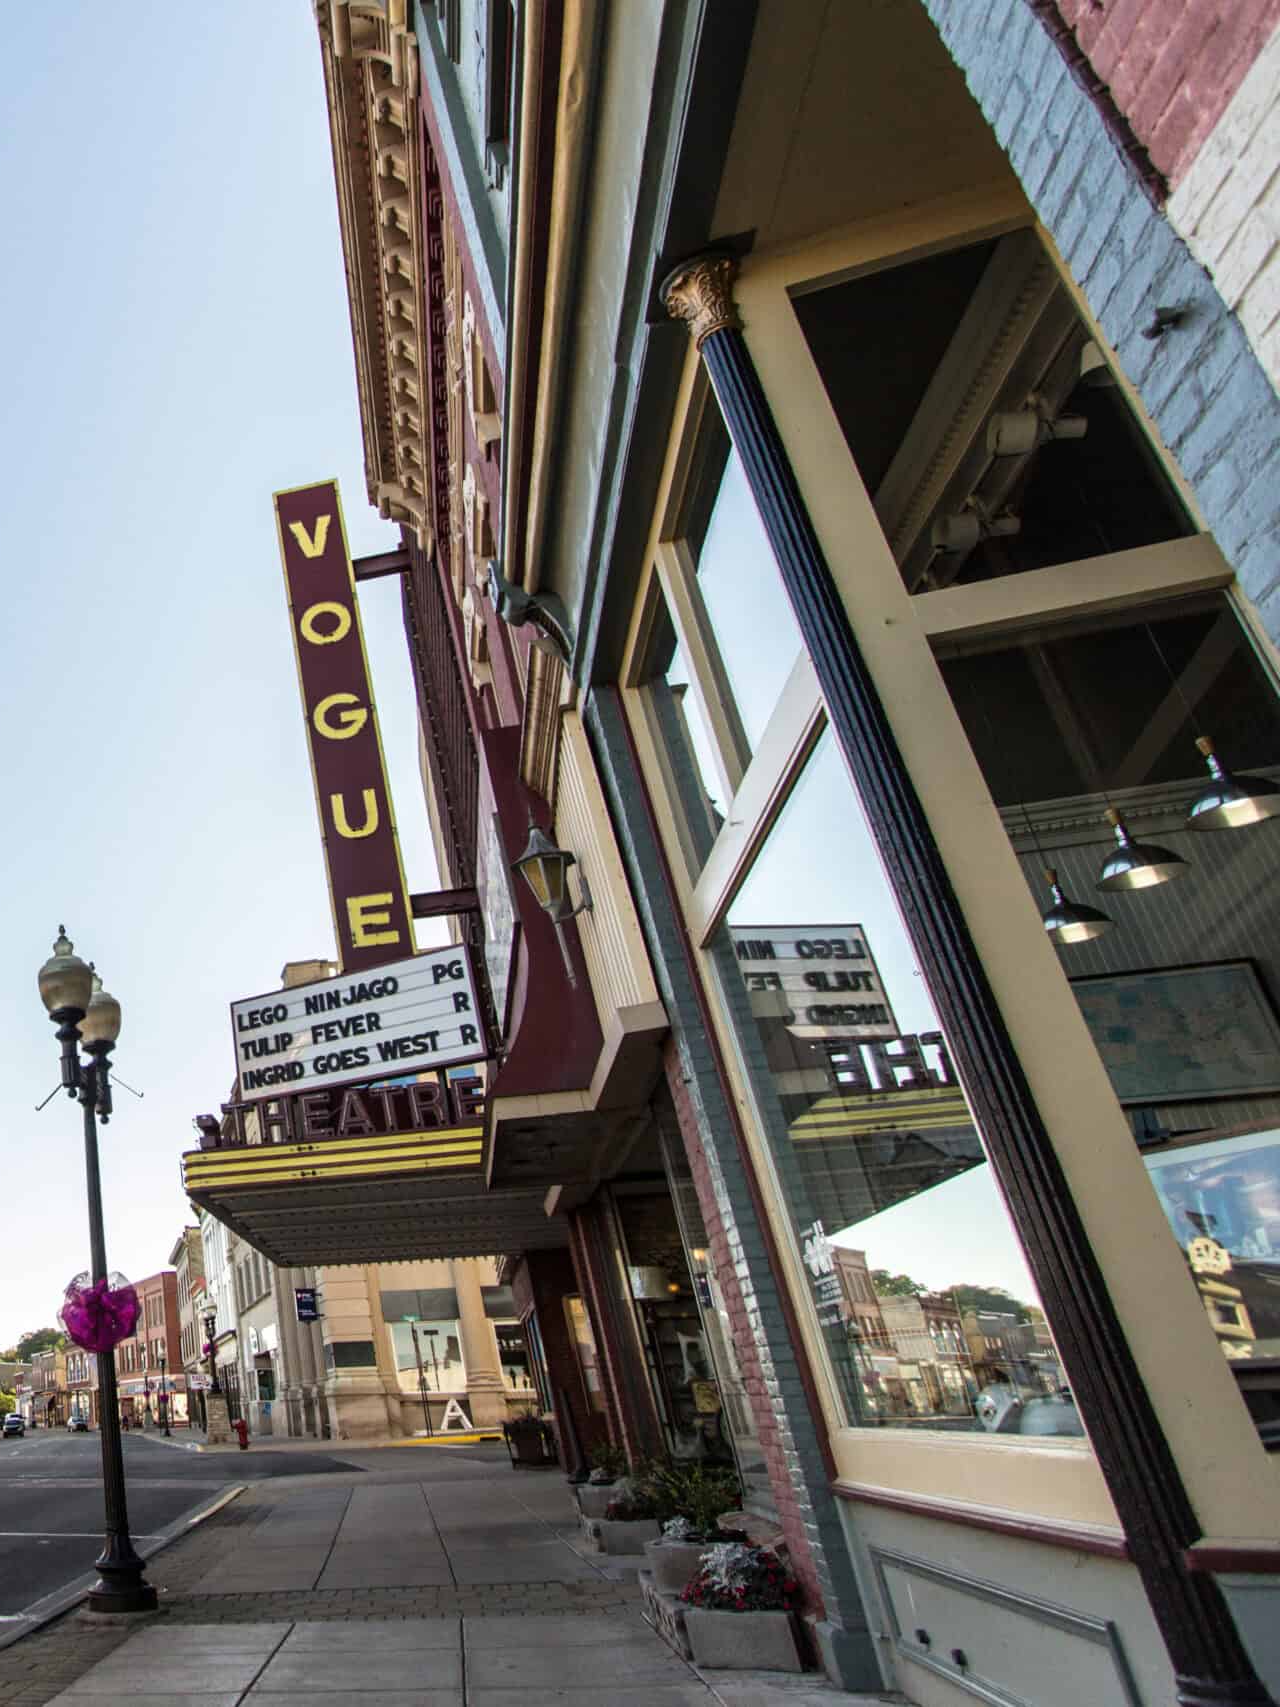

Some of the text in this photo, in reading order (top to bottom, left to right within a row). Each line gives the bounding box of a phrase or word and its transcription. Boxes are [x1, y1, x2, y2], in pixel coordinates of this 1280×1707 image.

[289, 514, 400, 948] VOGUE
[236, 959, 465, 1033] LEGO NINJAGO PG
[239, 992, 471, 1061] TULIP FEVER R
[242, 1023, 478, 1091] INGRID GOES WEST R
[221, 1074, 486, 1147] THEATRE
